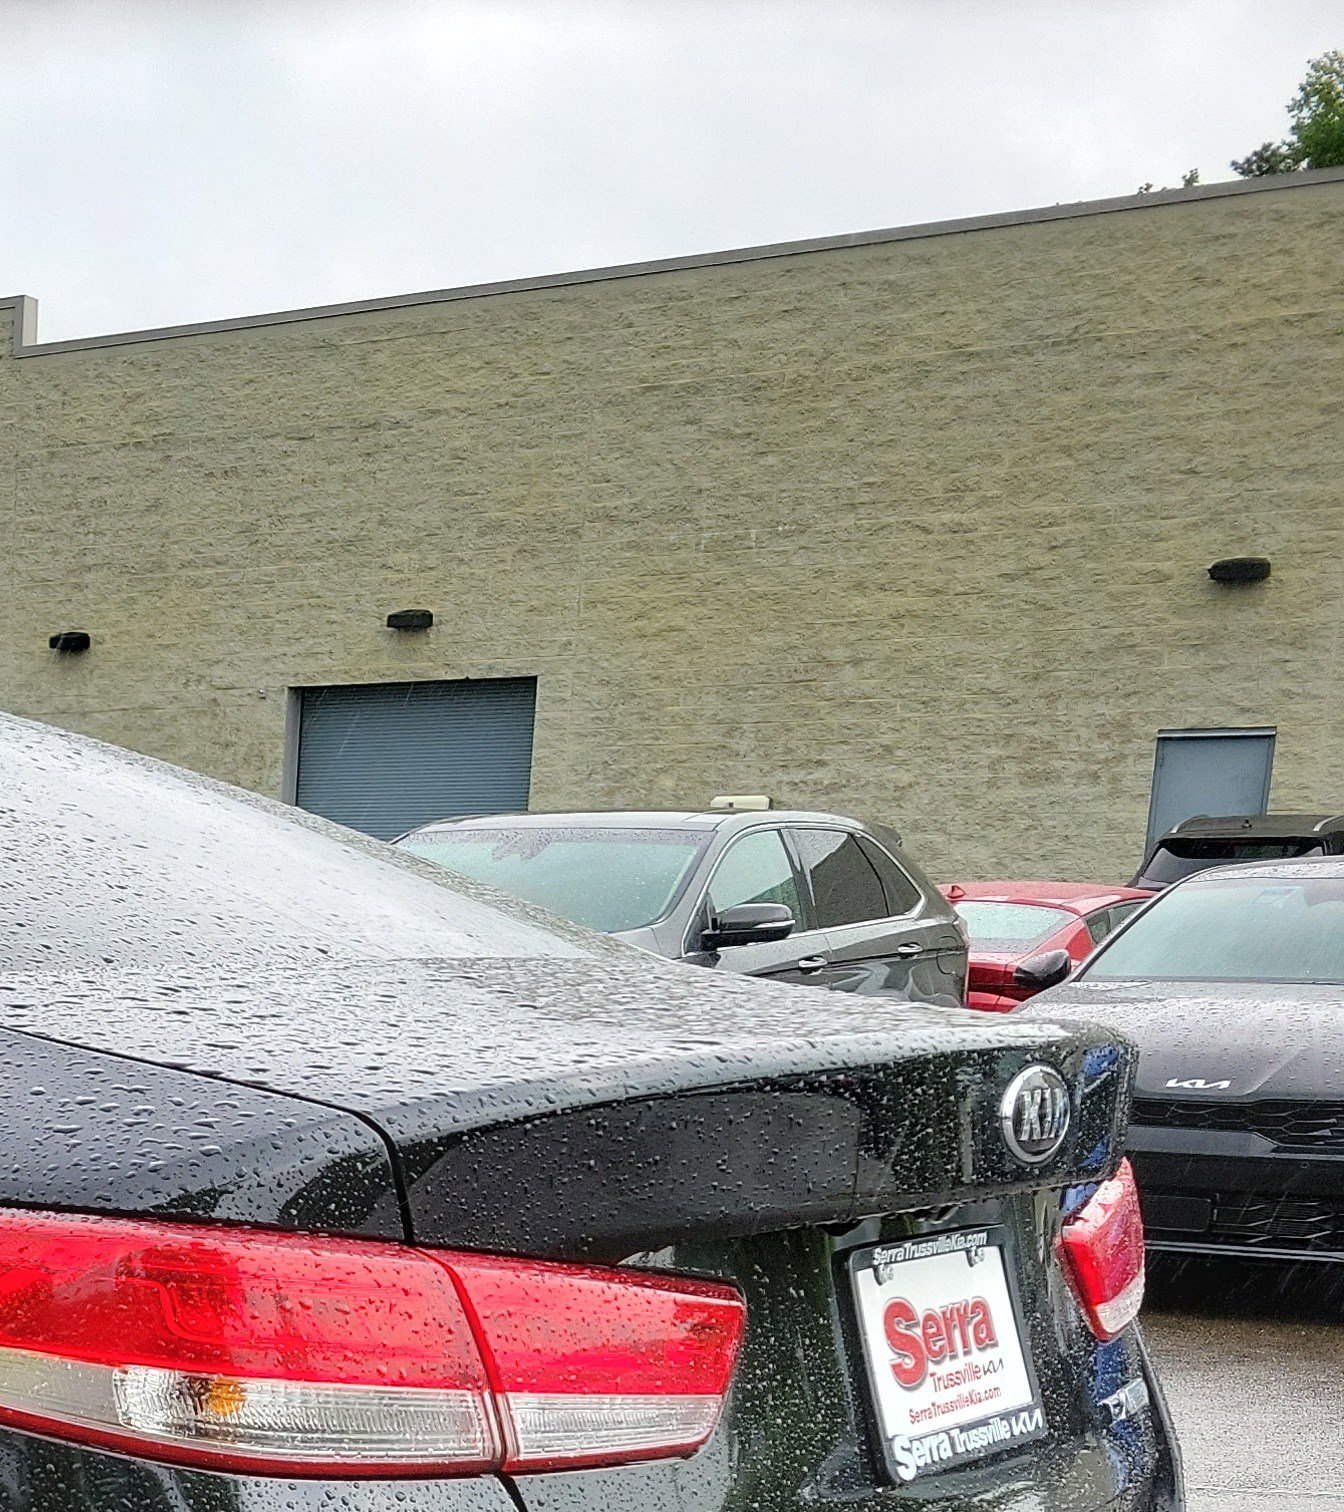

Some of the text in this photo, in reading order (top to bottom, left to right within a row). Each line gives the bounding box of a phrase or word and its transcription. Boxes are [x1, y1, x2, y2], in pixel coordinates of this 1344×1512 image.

[872, 1231, 988, 1265] SerraTrussvilleKia.com
[882, 1296, 1000, 1389] Serra
[929, 1361, 982, 1393] Trussville
[908, 1386, 1002, 1424] SerraTrussvilleKia.com
[892, 1433, 950, 1480] Serra
[951, 1418, 1011, 1451] Trussville
